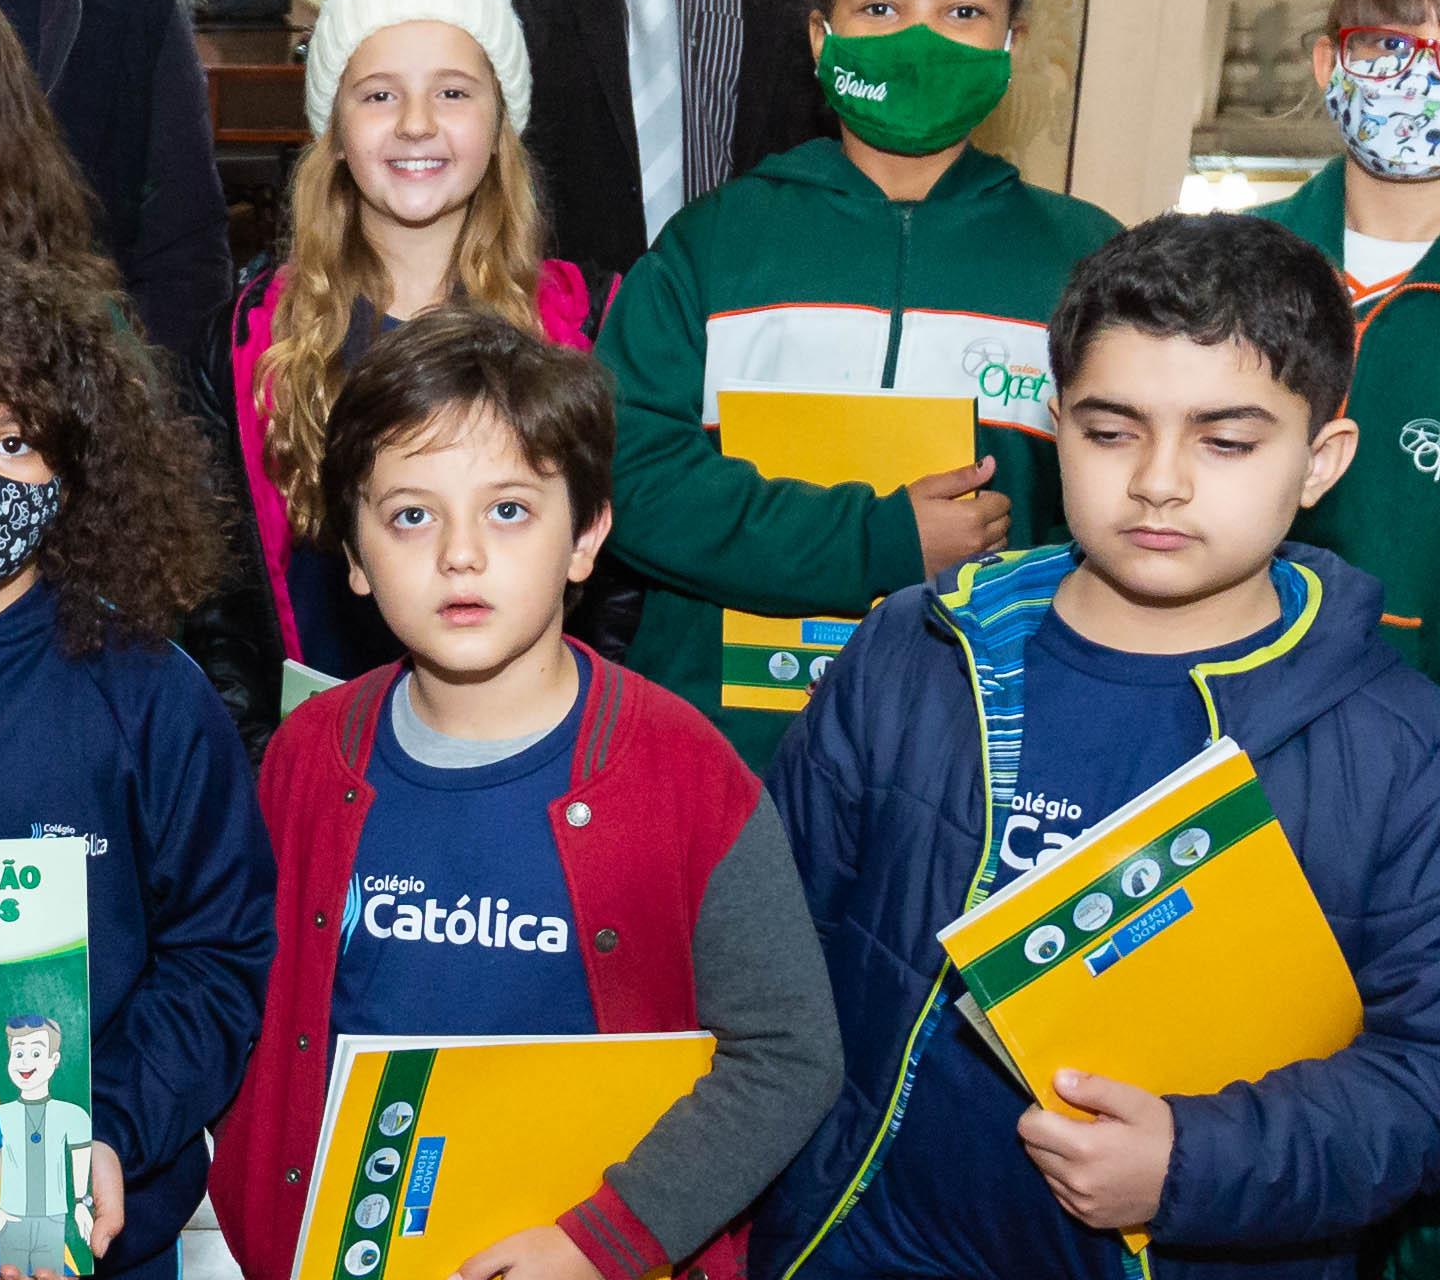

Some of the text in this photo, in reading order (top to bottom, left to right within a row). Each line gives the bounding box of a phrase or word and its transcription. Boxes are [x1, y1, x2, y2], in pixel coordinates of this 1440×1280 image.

[979, 362, 1050, 407] Opet
[813, 632, 852, 642] FEDERA
[1011, 791, 1082, 820] olégio
[364, 875, 425, 894] Colégio
[364, 894, 569, 953] Católica
[1127, 899, 1175, 935] FEDERAL
[1131, 909, 1178, 944] SENADO
[410, 1149, 428, 1193] FEDERAL
[421, 1149, 438, 1195] SENADO
